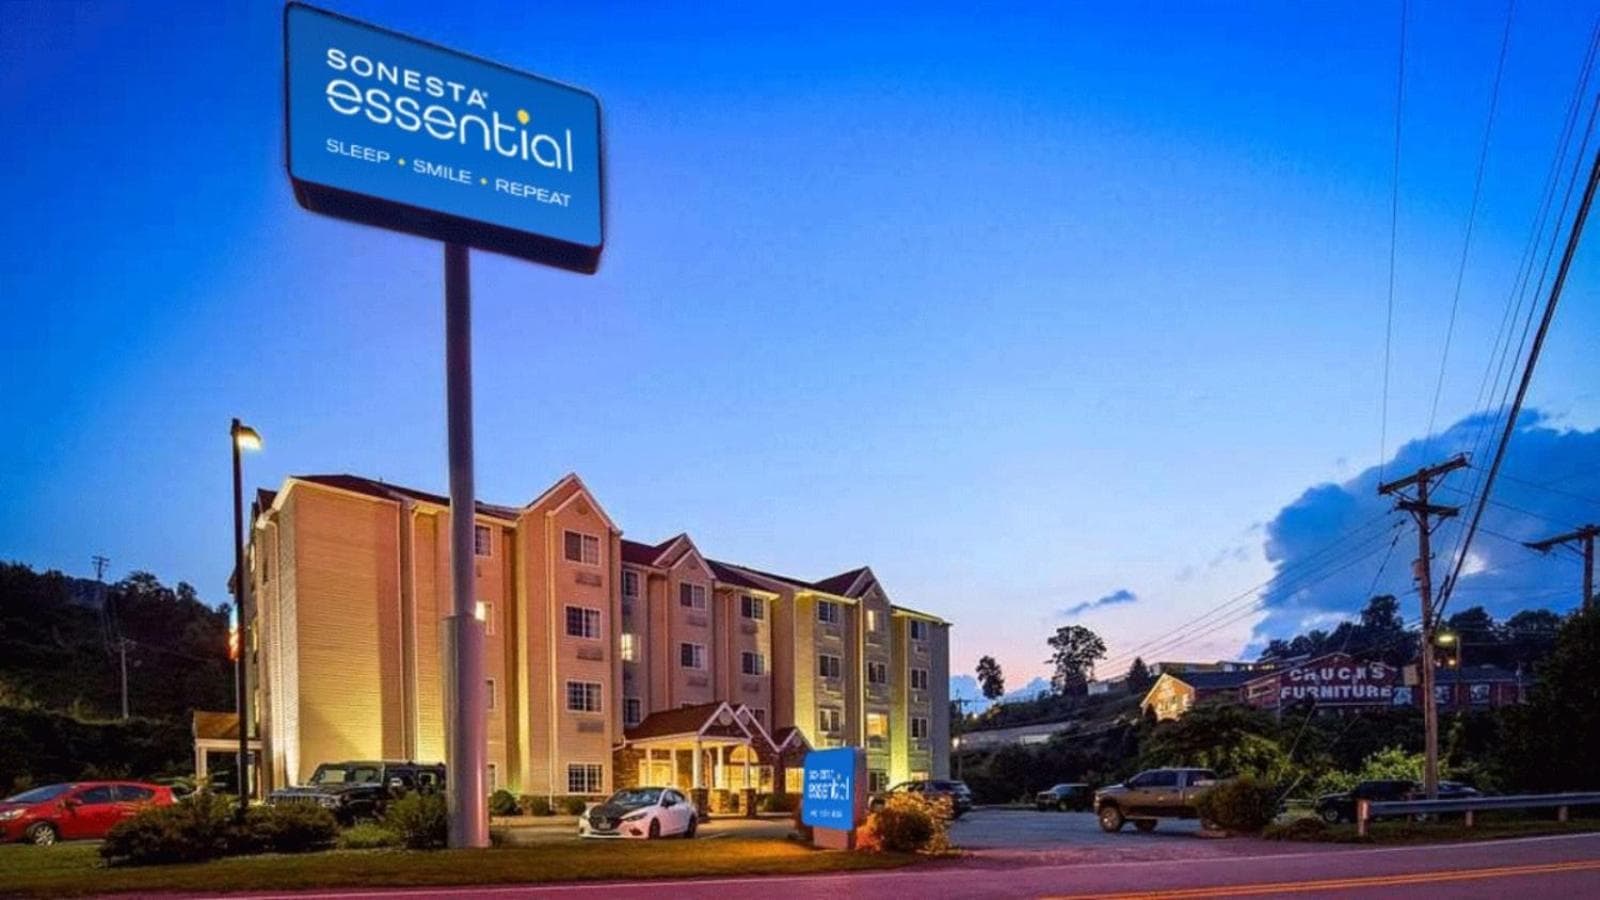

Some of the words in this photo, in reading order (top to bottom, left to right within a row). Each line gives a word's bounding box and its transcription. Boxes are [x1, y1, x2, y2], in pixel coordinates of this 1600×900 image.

[326, 48, 487, 109] SONESTA
[326, 79, 573, 172] essential
[326, 138, 390, 163] SLEEP
[413, 159, 472, 184] SMILE
[495, 178, 572, 207] REPEAT
[1280, 685, 1392, 699] FURNITURE
